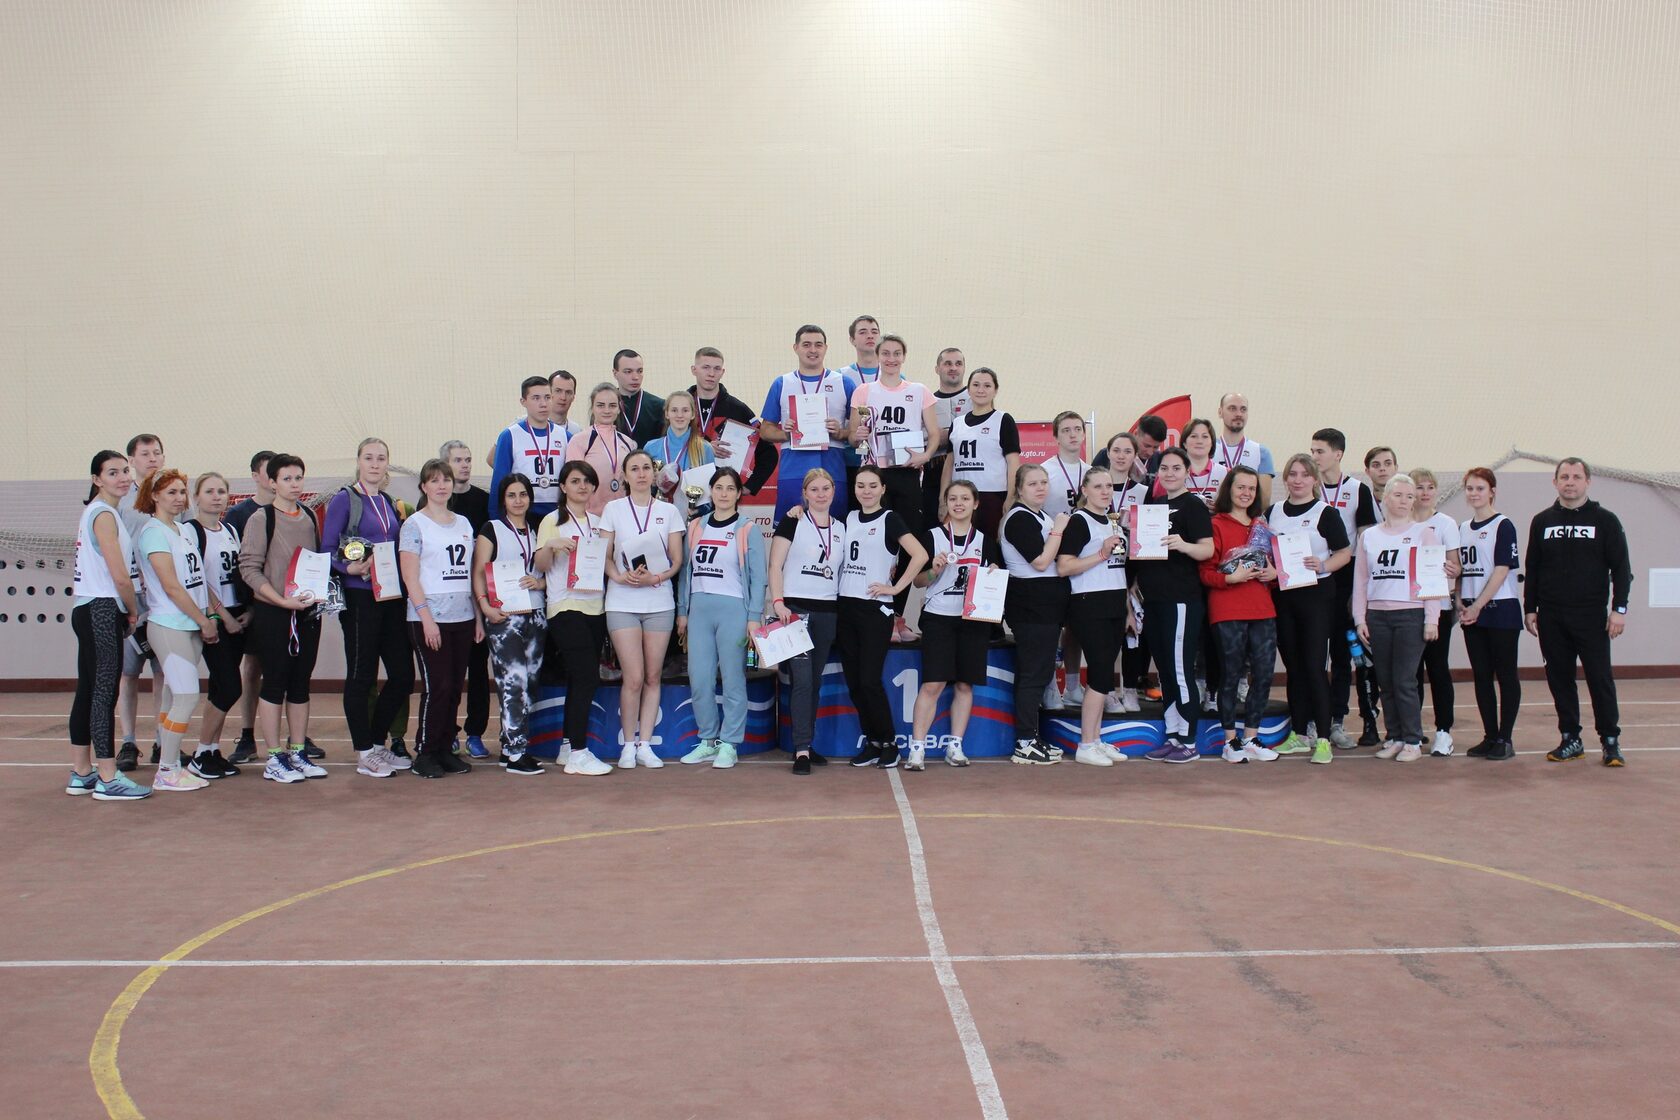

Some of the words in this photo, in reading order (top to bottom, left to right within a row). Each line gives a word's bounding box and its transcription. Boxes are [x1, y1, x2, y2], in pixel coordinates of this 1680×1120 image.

[880, 406, 905, 425] 40
[960, 440, 977, 458] 41
[534, 457, 554, 475] 61
[755, 517, 771, 526] ГТО
[1547, 526, 1590, 540] ASICS
[445, 544, 466, 566] 12
[695, 546, 718, 564] 57
[819, 543, 828, 564] 7
[850, 540, 860, 562] 6
[1377, 549, 1399, 567] 47
[1460, 545, 1477, 565] 50
[892, 668, 918, 723] 1
